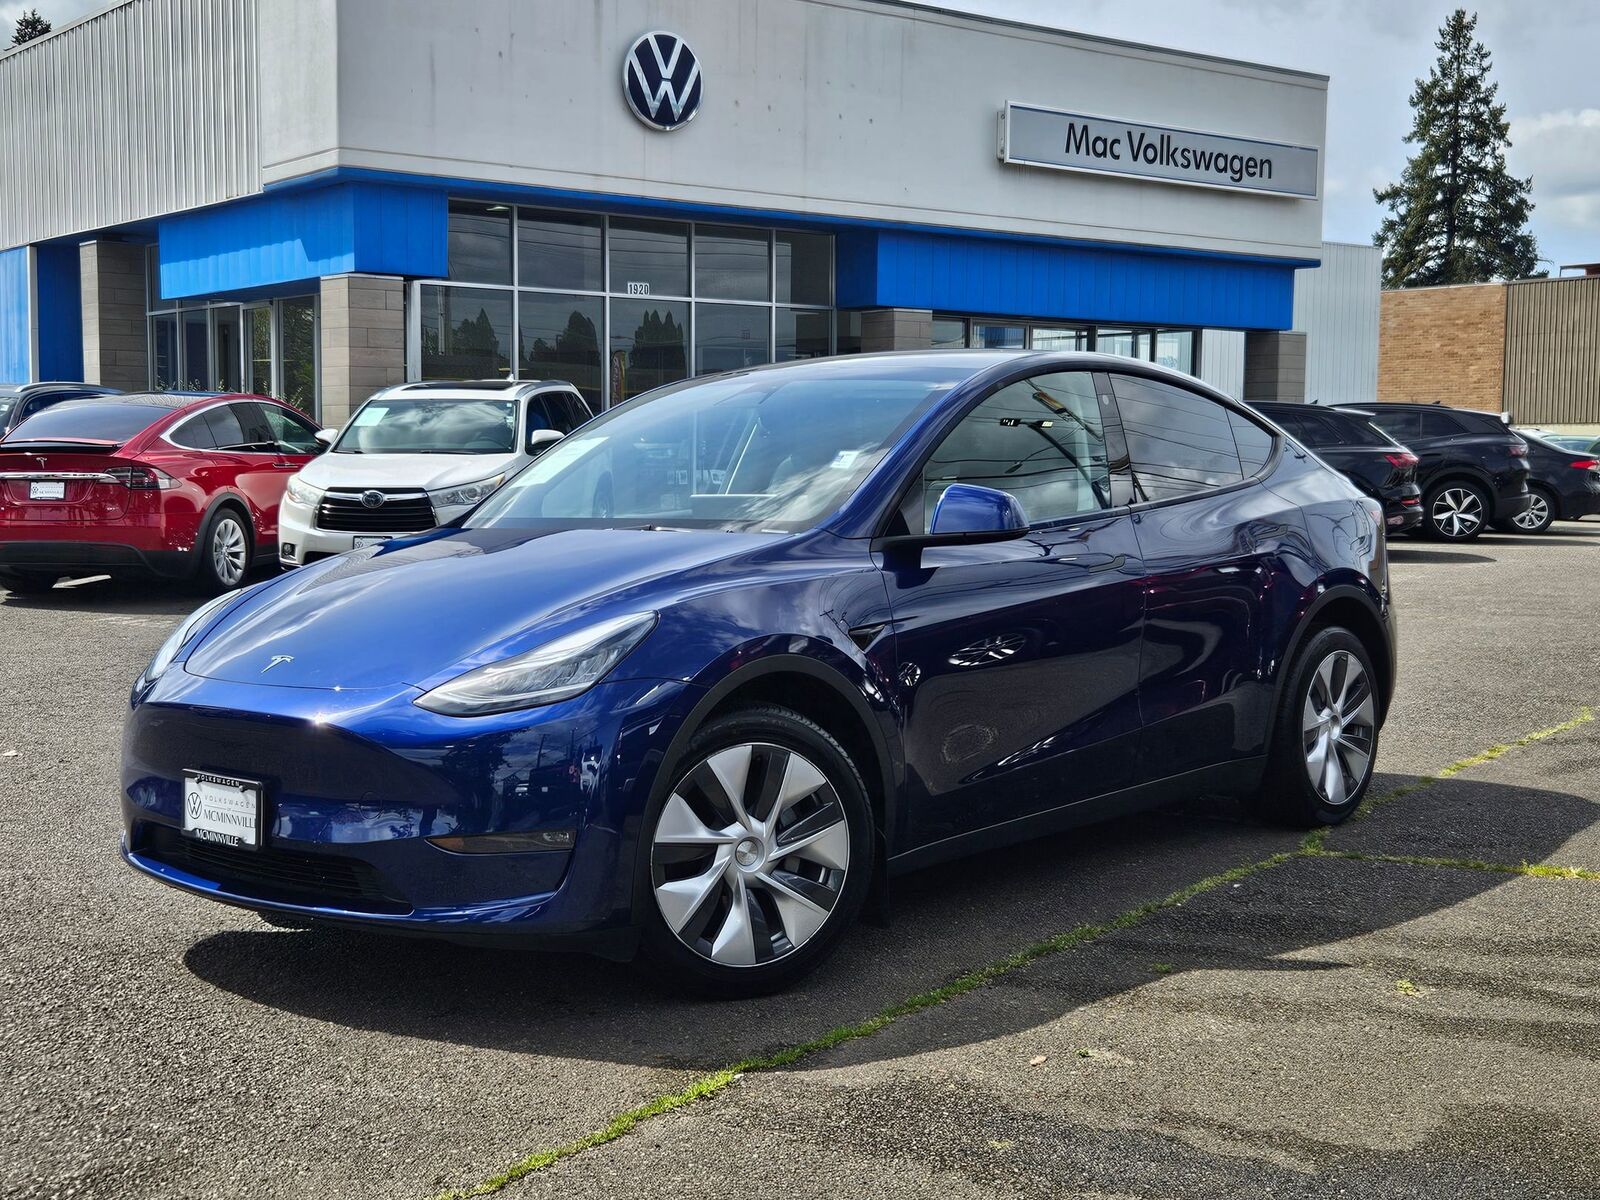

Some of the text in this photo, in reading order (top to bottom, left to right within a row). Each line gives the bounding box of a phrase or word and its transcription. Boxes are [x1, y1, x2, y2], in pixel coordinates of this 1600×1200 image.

[1064, 122, 1273, 183] Mac Volkswagen
[628, 283, 649, 295] 1920
[204, 795, 256, 809] VOLKSWAGEN
[203, 809, 256, 829] MCMINNVILL
[196, 829, 239, 847] MCMINNVILLE
